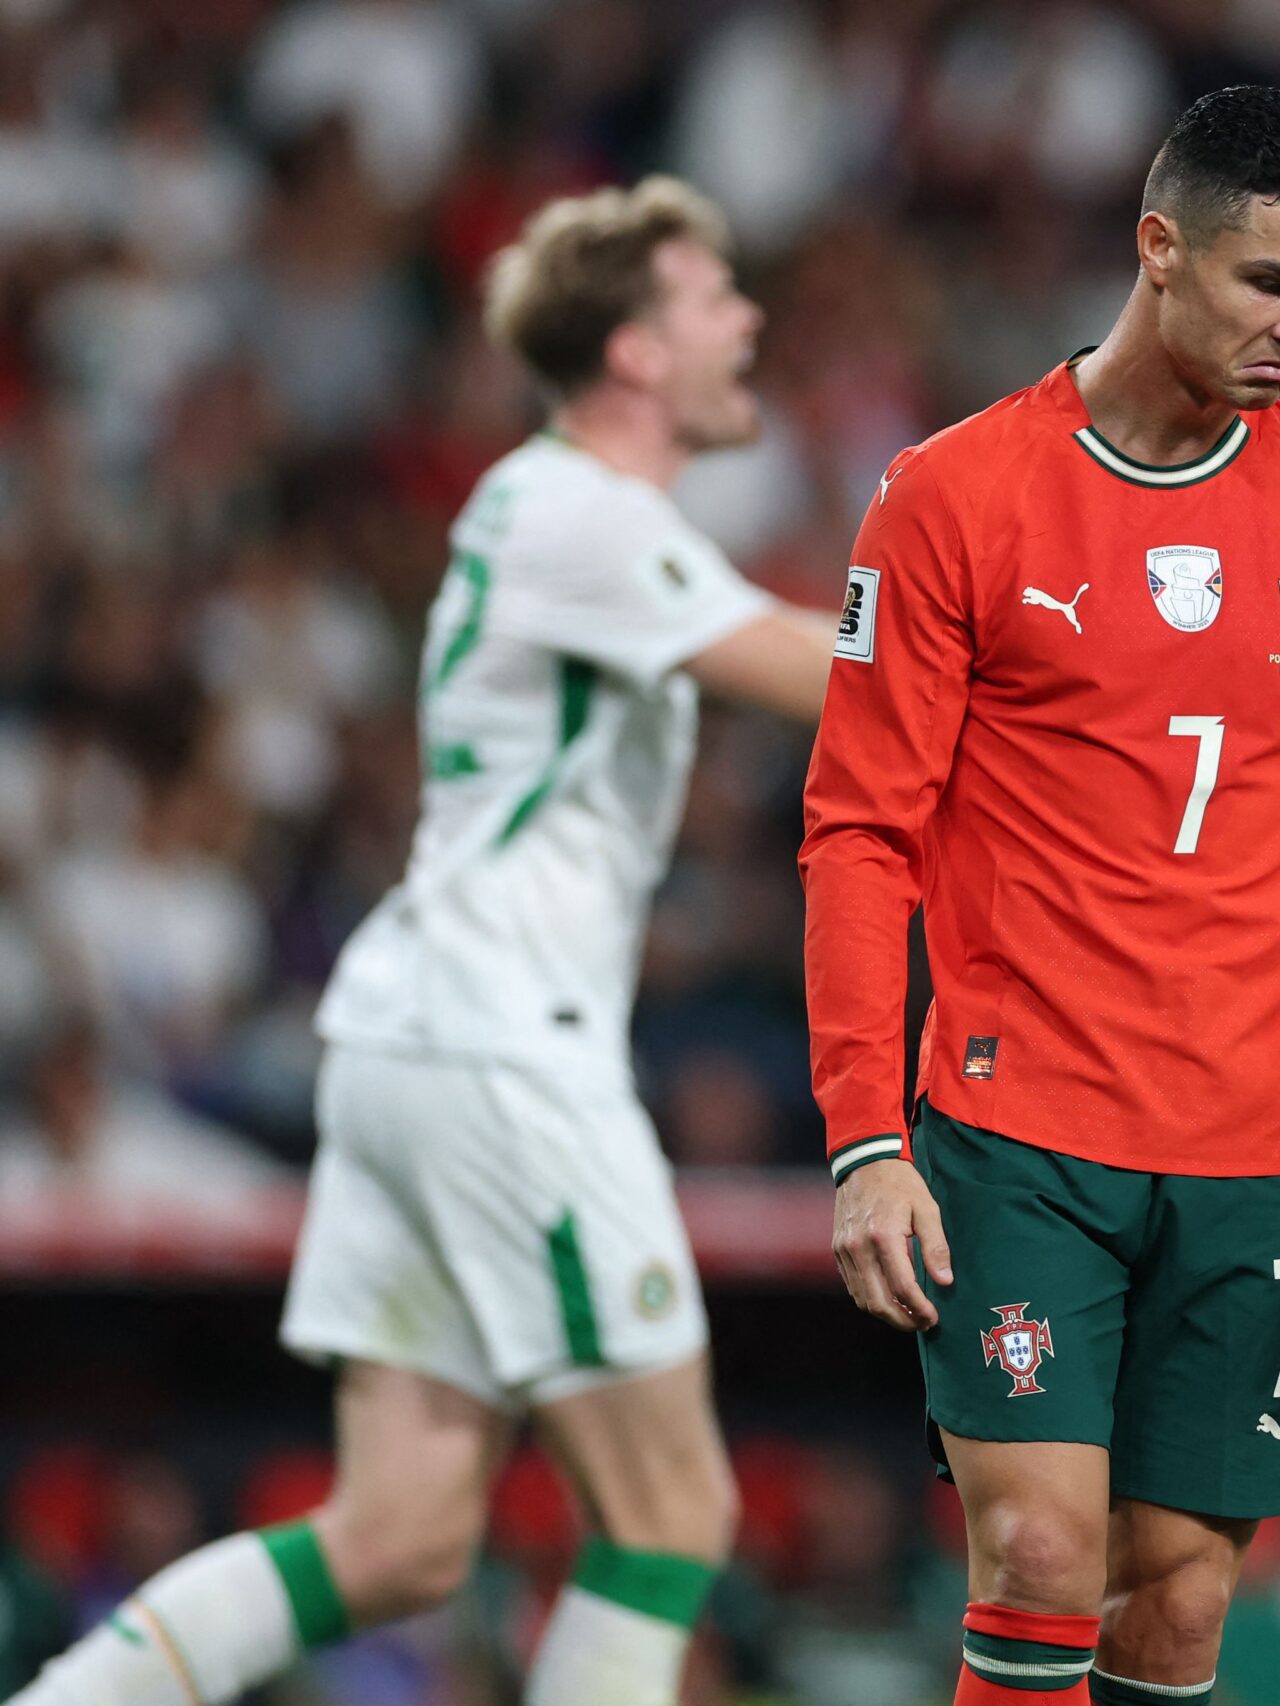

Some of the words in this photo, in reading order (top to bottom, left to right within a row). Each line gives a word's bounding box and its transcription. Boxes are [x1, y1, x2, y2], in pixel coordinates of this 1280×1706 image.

[1192, 549, 1216, 558] LEAGUE
[1172, 620, 1197, 629] WINNER
[1168, 715, 1226, 854] 7
